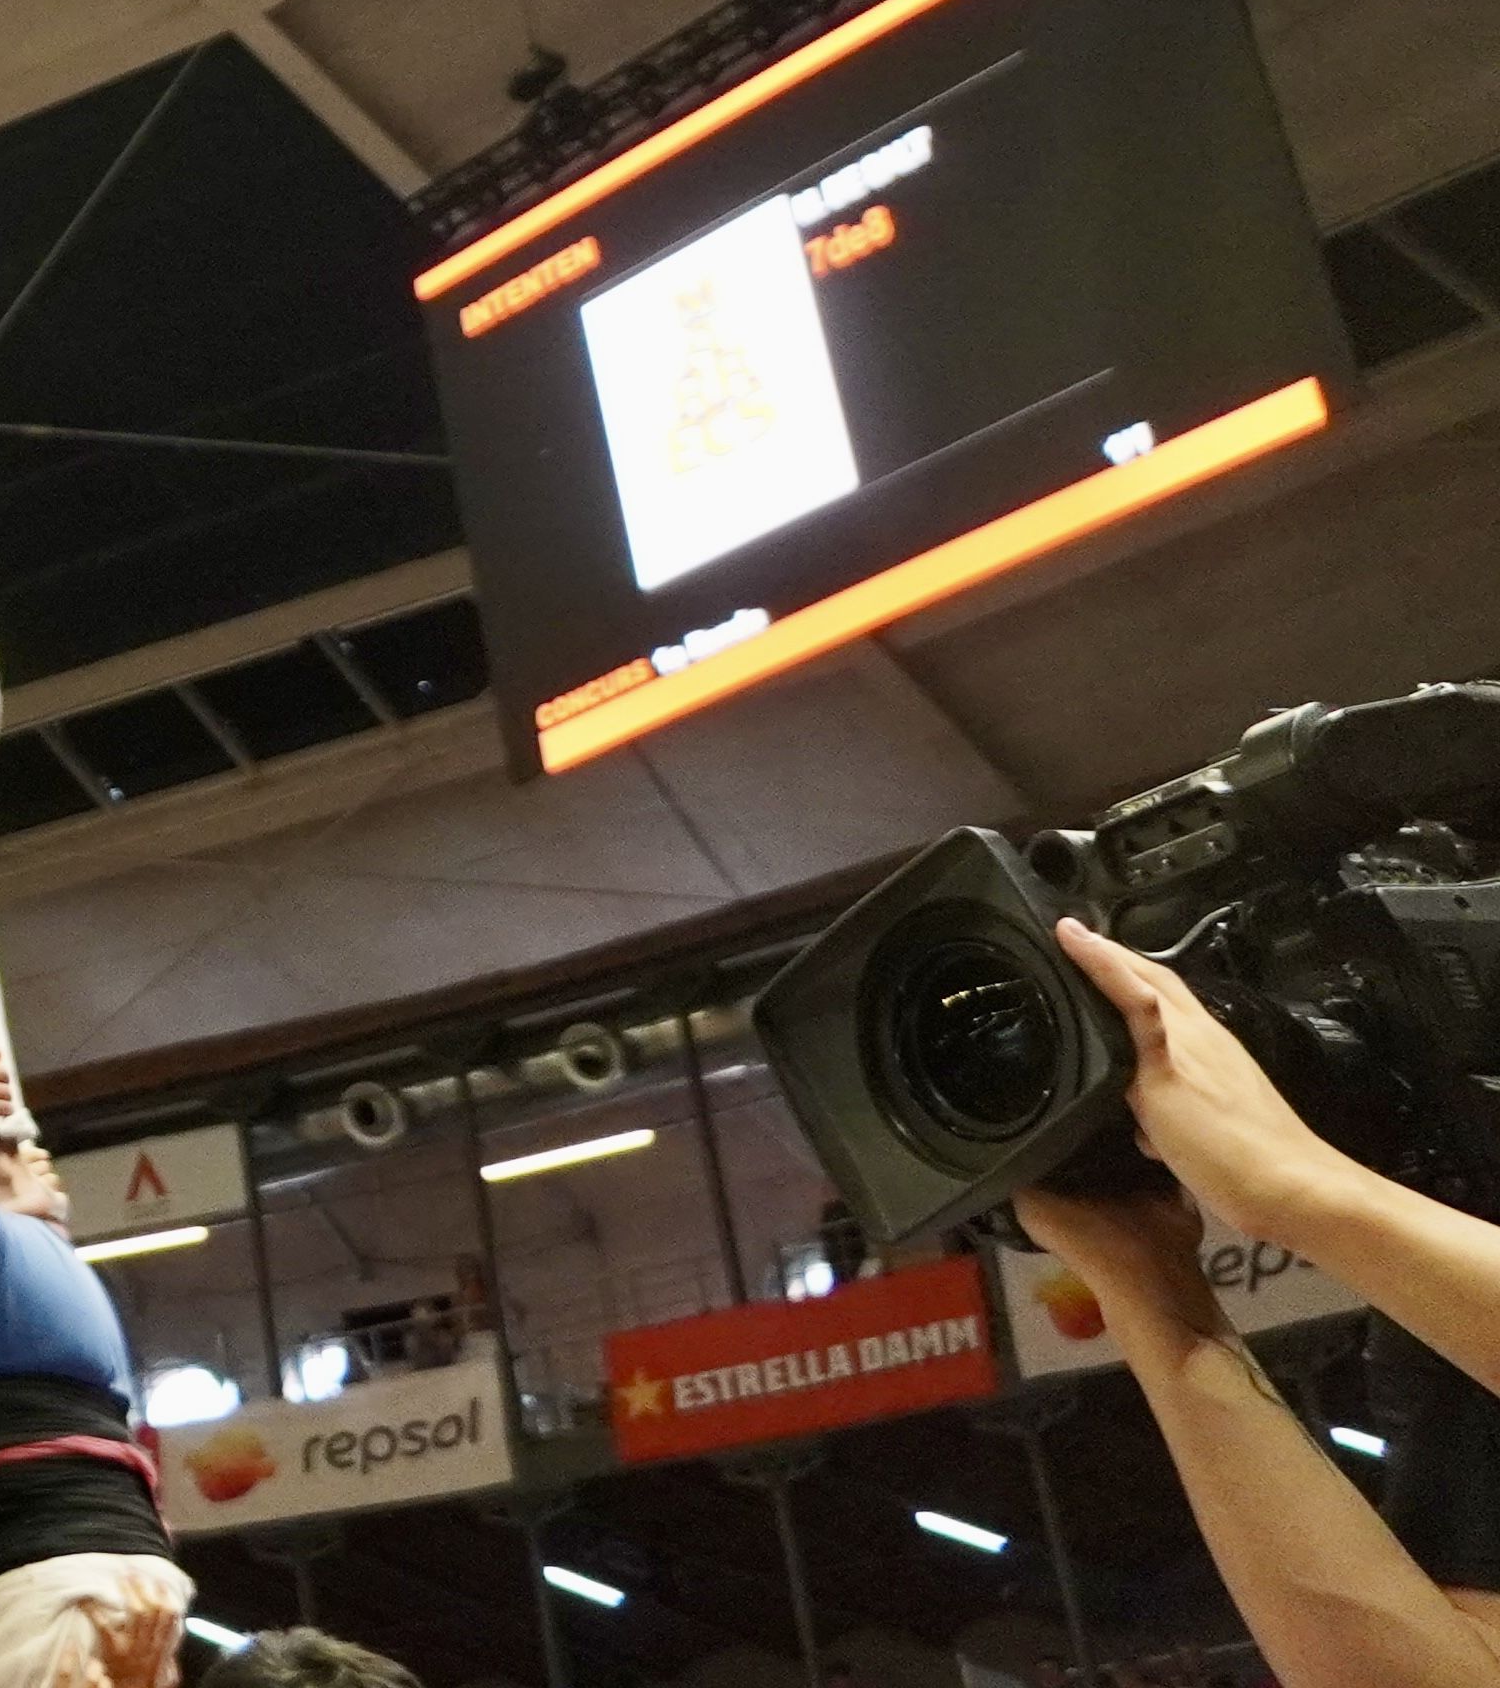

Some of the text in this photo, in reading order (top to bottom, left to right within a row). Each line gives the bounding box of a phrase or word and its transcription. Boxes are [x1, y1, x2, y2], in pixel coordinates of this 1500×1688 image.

[672, 1315, 979, 1411] ESTRELLA DAMM
[302, 1396, 480, 1475] repsol
